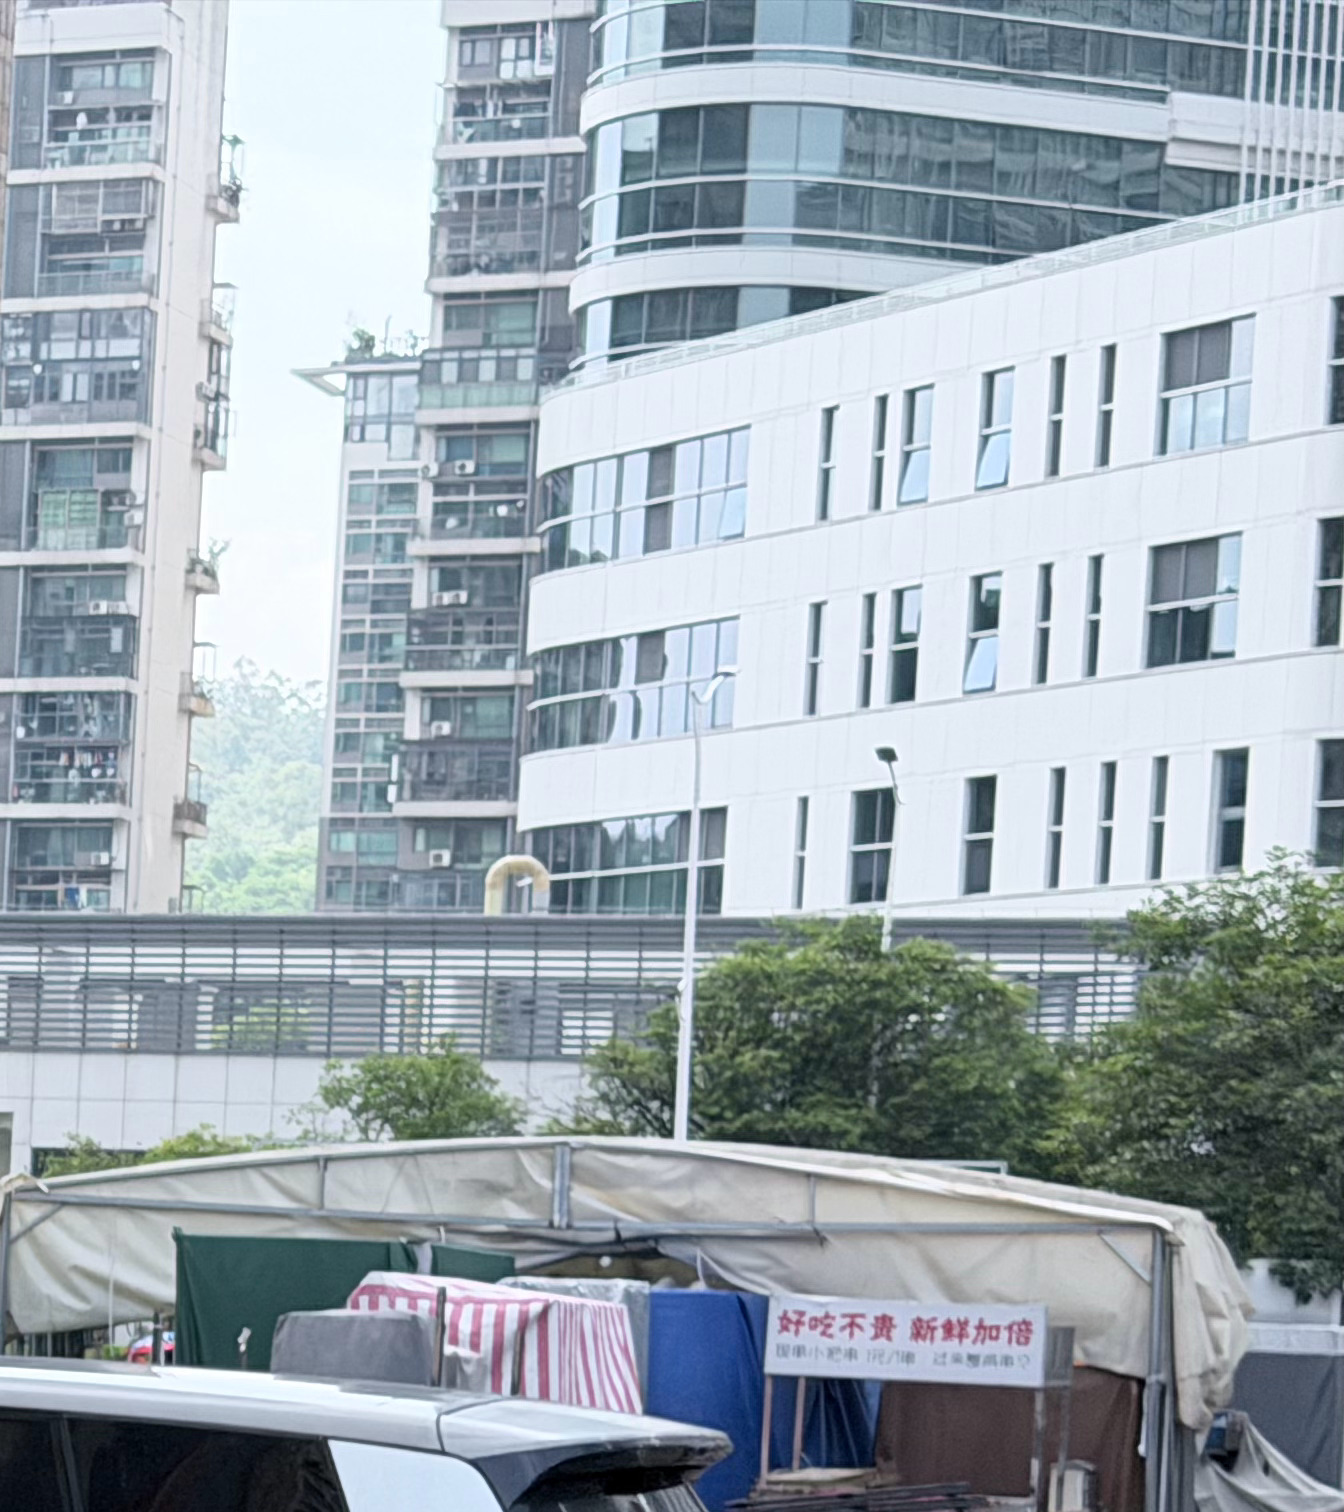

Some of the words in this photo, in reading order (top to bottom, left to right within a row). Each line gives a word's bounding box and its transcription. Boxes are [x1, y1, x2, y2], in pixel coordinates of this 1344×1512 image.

[777, 1309, 898, 1344] 好吃不贵
[909, 1316, 1034, 1347] 新鲜加倍
